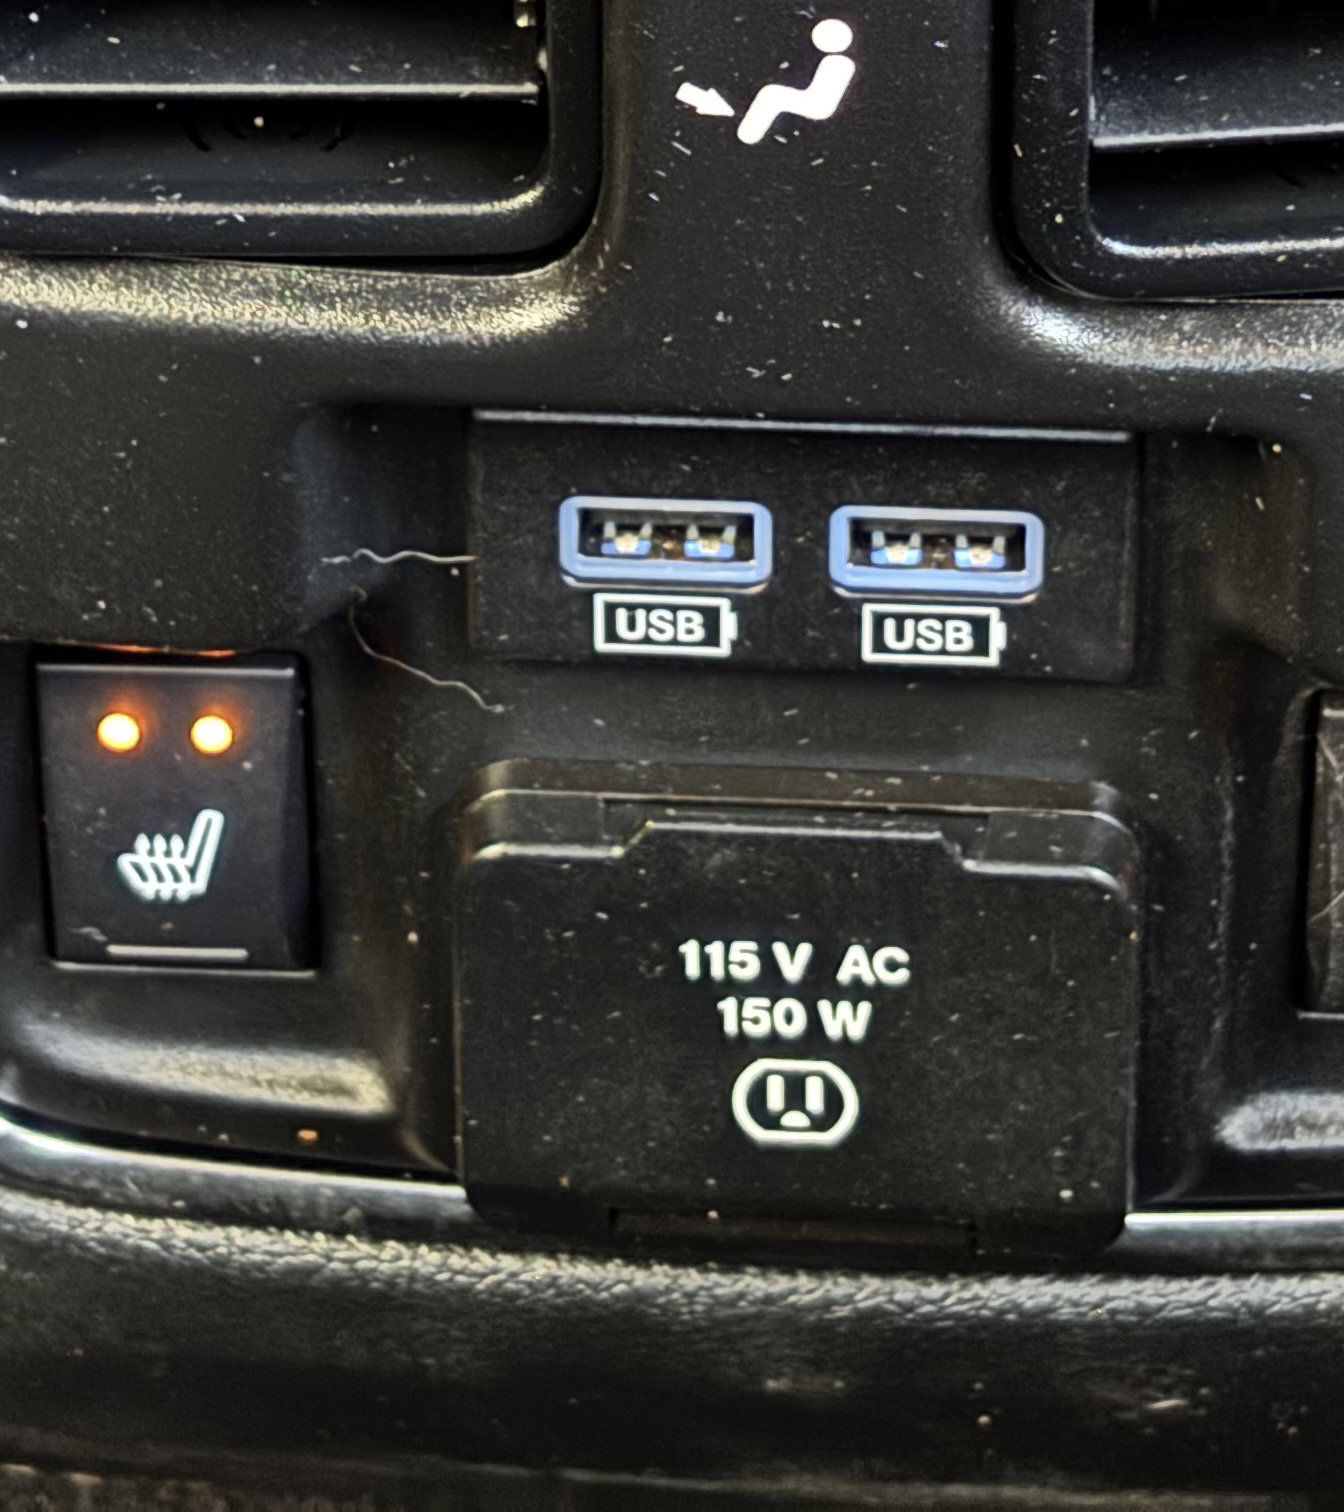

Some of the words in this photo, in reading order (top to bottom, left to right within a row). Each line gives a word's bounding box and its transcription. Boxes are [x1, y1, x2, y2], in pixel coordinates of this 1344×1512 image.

[615, 607, 706, 643] USB
[883, 617, 974, 653] USB
[678, 938, 761, 982] 115
[771, 941, 813, 984] V
[836, 944, 911, 986] AC
[716, 996, 808, 1039] 150
[816, 998, 873, 1041] W
